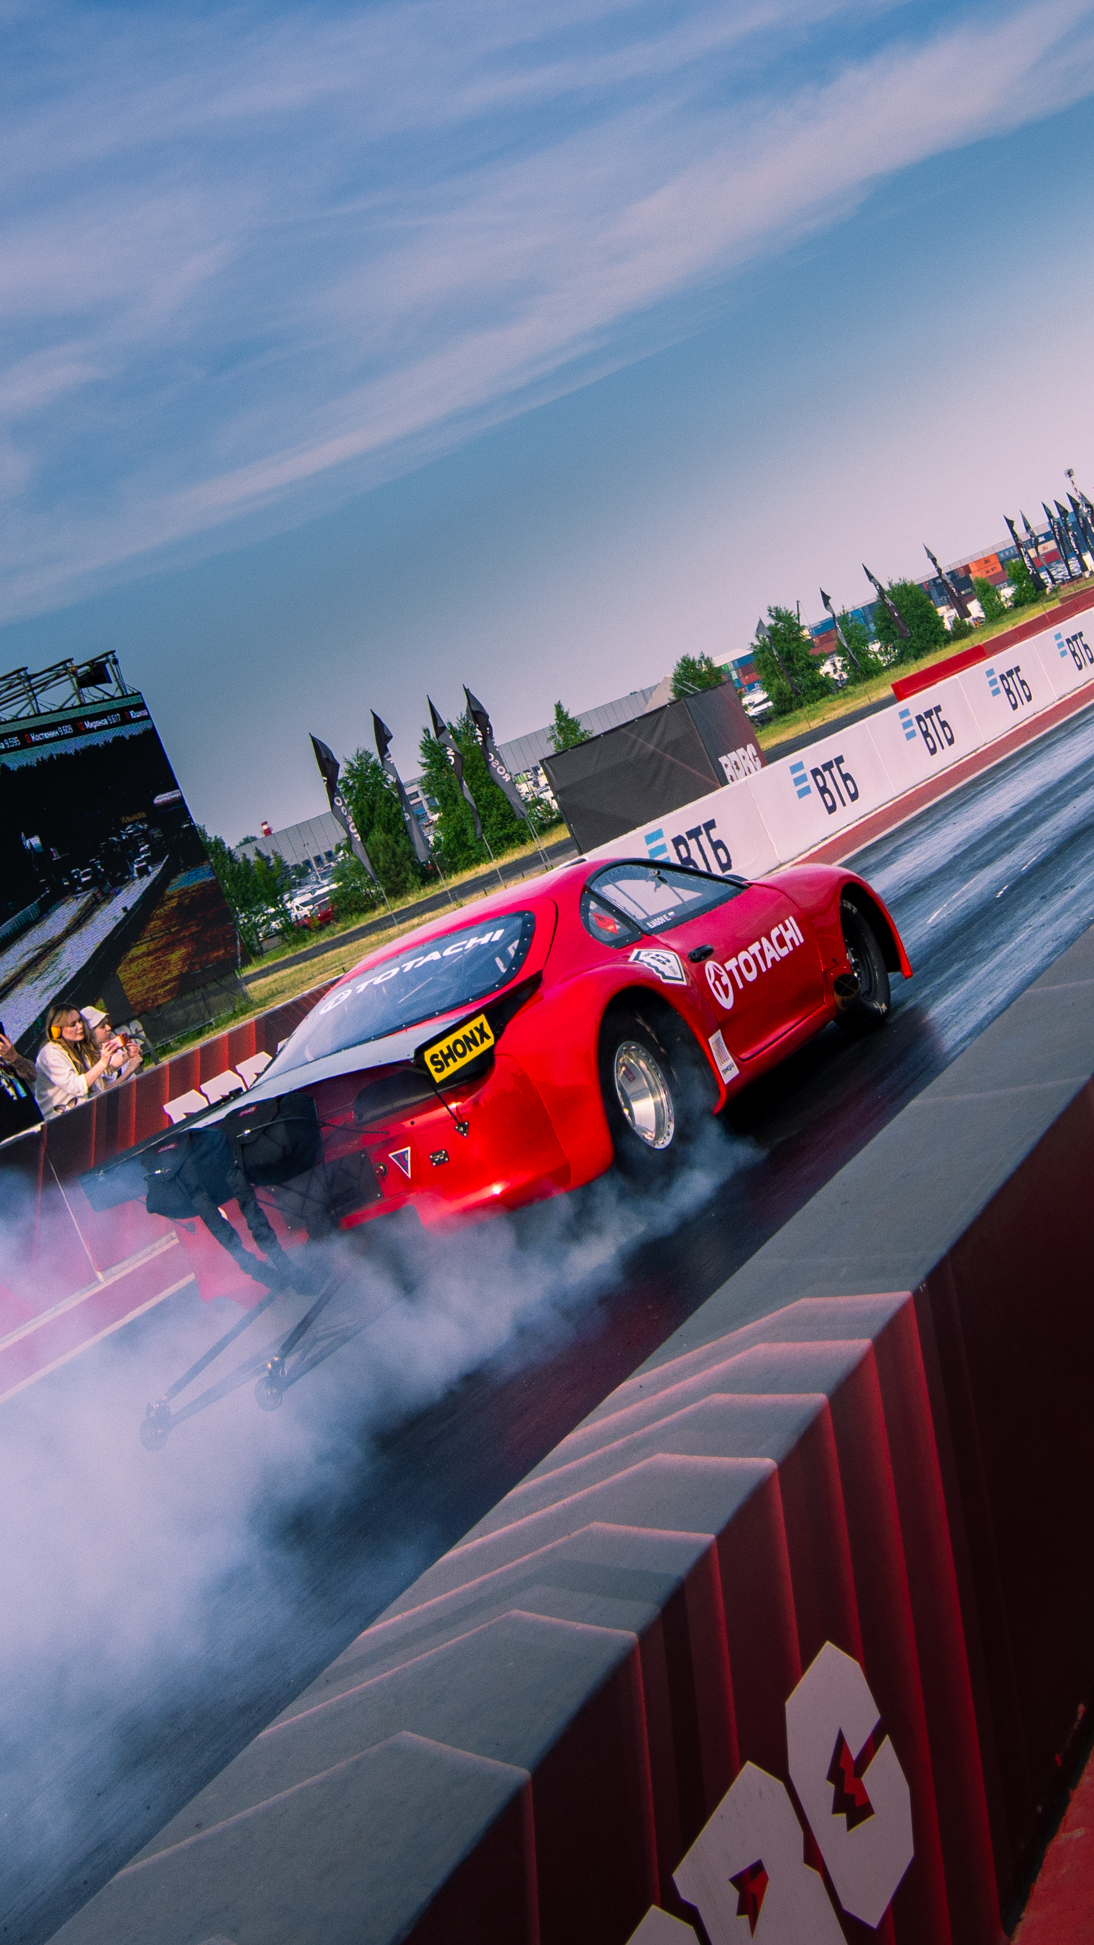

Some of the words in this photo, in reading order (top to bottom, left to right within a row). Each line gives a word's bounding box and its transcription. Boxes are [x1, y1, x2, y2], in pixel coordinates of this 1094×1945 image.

[1065, 631, 1094, 671] ВТБ
[998, 665, 1033, 711] ВТБ
[915, 704, 955, 756] ВТБ
[810, 755, 859, 815] ВТБ
[670, 819, 733, 873] ВТБ
[355, 929, 505, 994] TOTACHI
[726, 916, 804, 990] TOTACHI
[429, 1021, 492, 1075] SHONX
